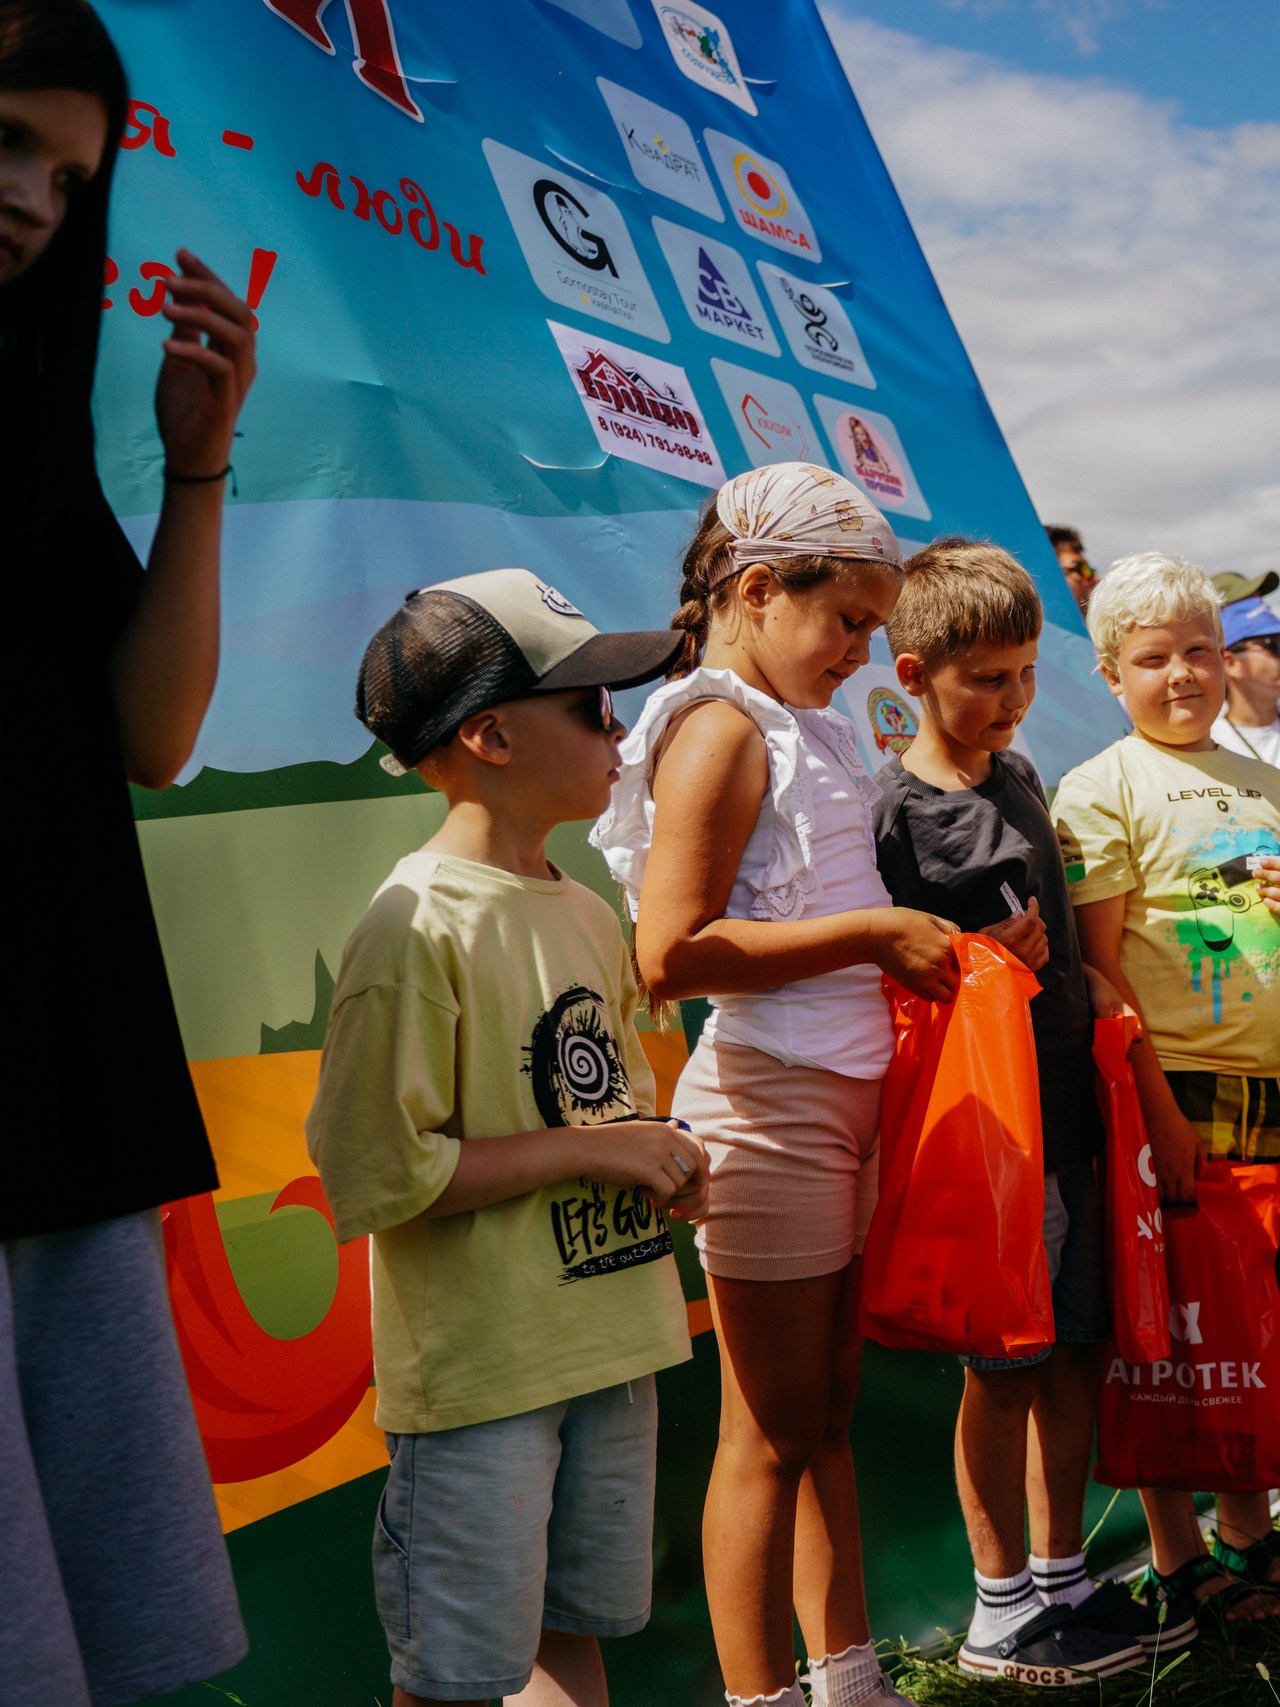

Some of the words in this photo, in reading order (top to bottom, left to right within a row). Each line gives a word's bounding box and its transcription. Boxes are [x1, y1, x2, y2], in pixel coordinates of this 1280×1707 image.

[296, 162, 487, 276] люди
[738, 208, 813, 251] ШАМСА
[696, 304, 764, 340] МАРКЕТ
[597, 416, 609, 431] 8
[610, 420, 647, 447] (924)
[645, 433, 713, 466] 791-98-98
[1167, 787, 1232, 802] LEVEL
[1130, 1393, 1176, 1403] КАЖДЫЙ
[1201, 1396, 1242, 1406] СВЕЖЕЕ
[1003, 1664, 1066, 1685] crocs
